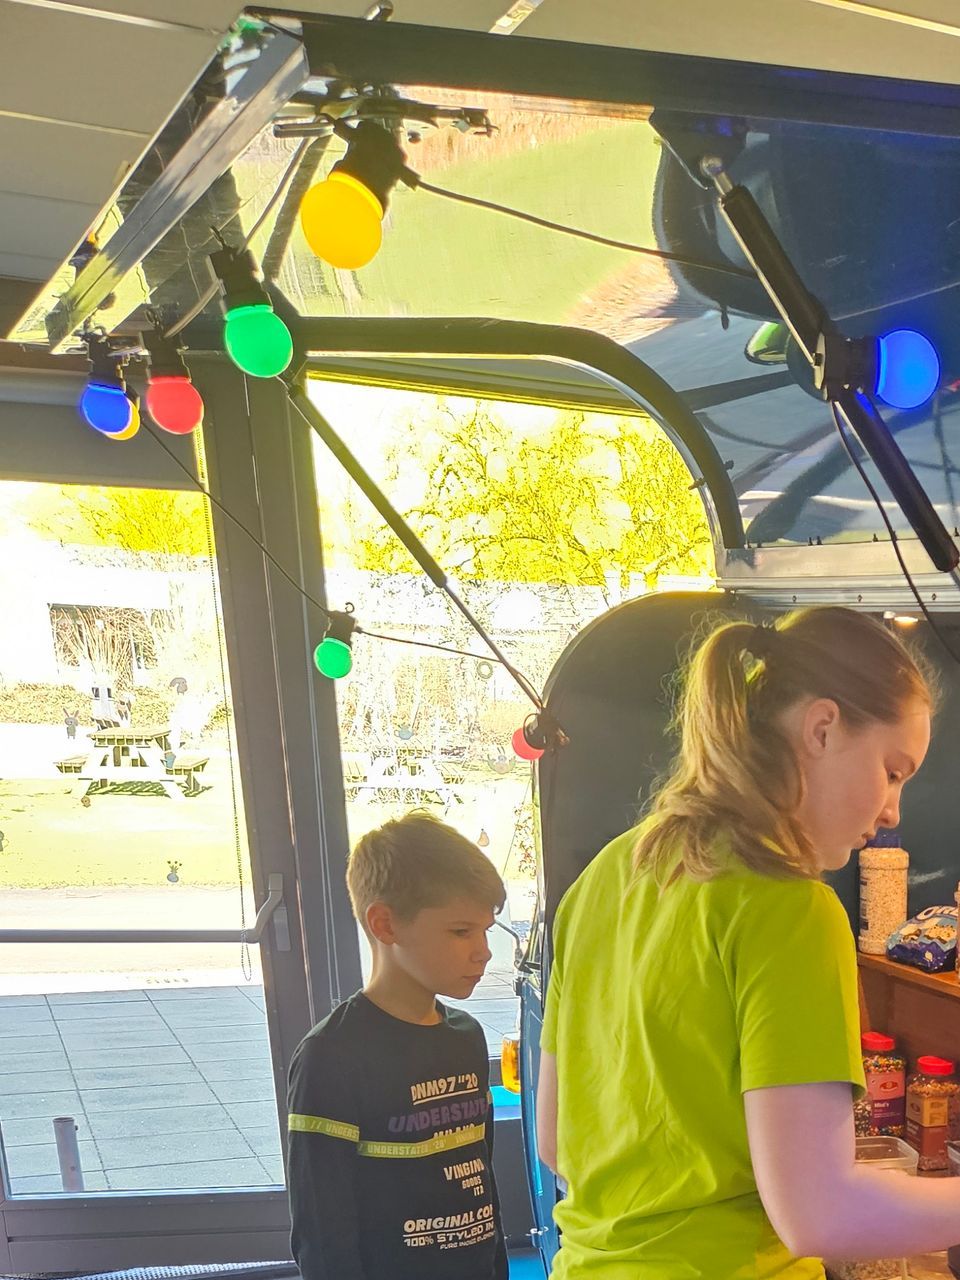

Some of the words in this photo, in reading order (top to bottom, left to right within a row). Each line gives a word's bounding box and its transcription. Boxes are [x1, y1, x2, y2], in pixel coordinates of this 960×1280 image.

[403, 1210, 475, 1233] ORIGINAL
[403, 1235, 434, 1247] 100%
[436, 1224, 484, 1243] STYLED
